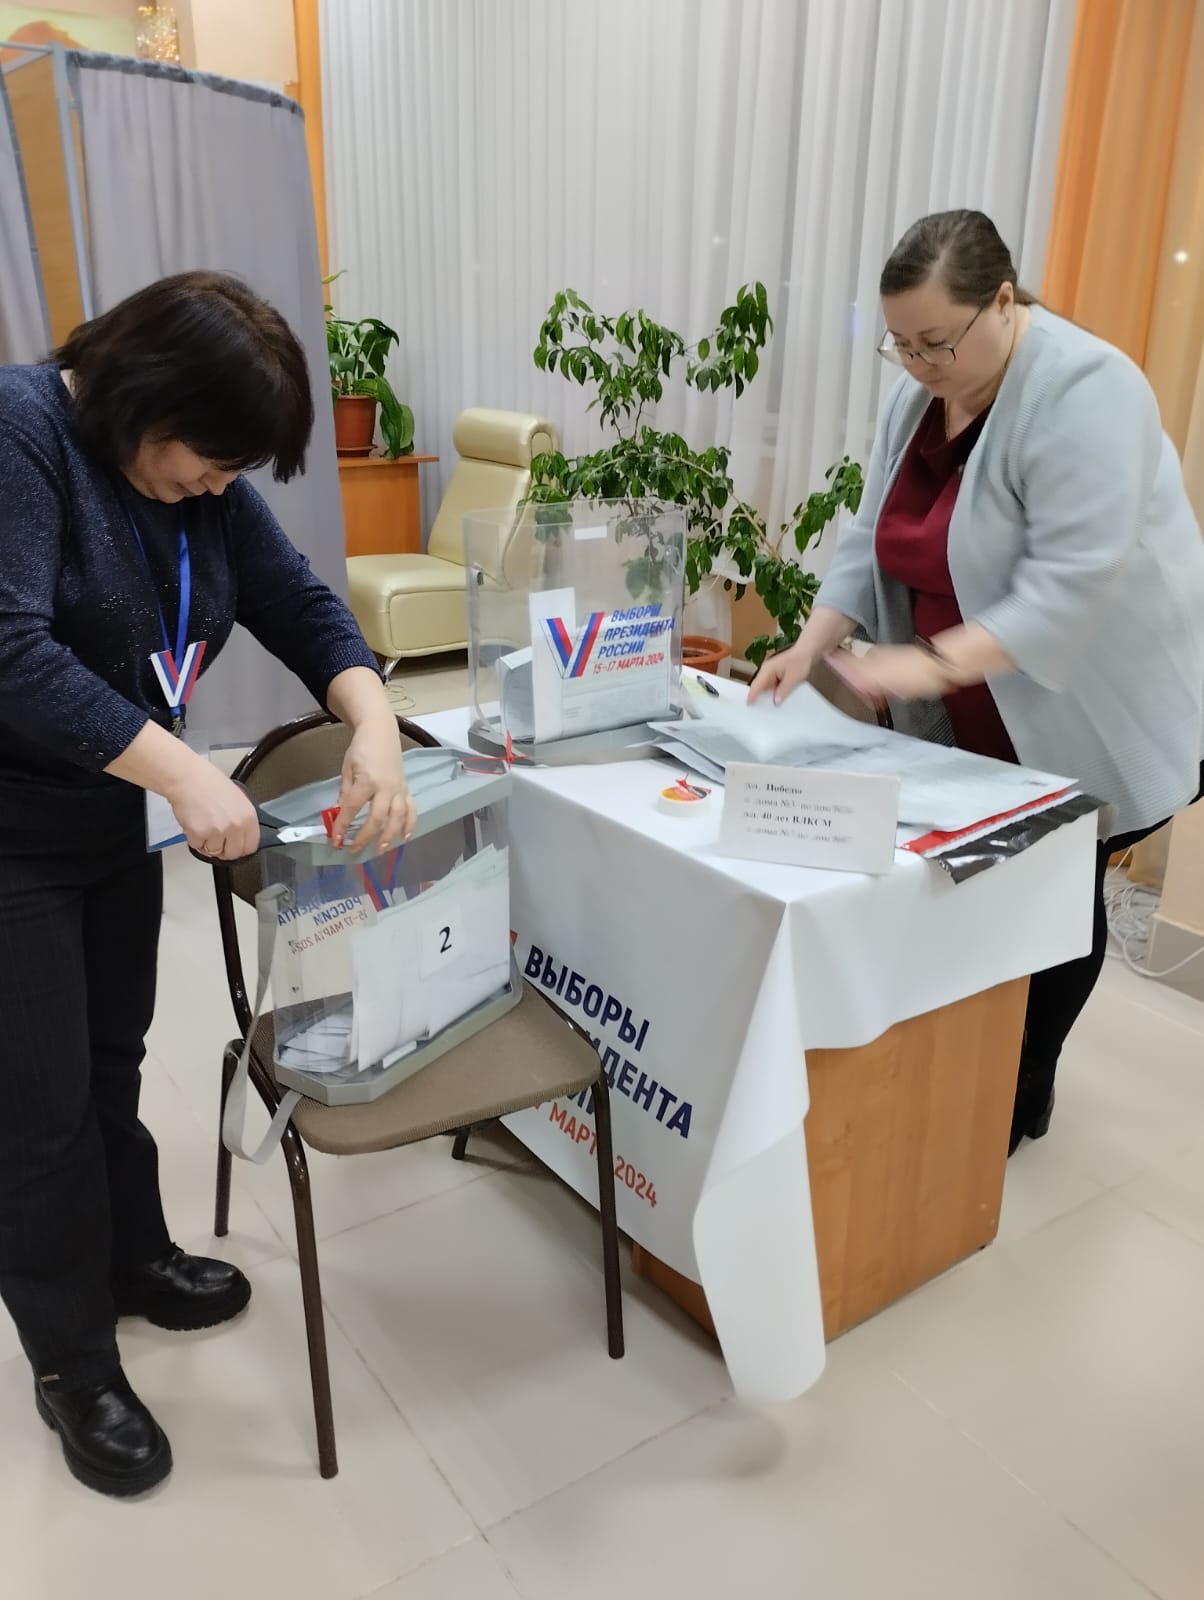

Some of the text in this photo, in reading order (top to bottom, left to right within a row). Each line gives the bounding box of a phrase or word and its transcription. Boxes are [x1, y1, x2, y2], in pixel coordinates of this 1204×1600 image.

[610, 603, 663, 623] ВЫБОРЫ
[604, 617, 675, 641] ПРЕЗИДЕНТА
[597, 640, 645, 659] РОССИИ
[617, 655, 645, 670] МАРТА
[645, 652, 665, 666] 2024
[792, 815, 832, 828] ВЛКСМ
[438, 926, 453, 954] 2
[523, 944, 650, 1053] ВЫБОРЫ
[585, 1029, 694, 1139] ДЕНТА
[548, 1101, 658, 1208] МАРТ 2024
